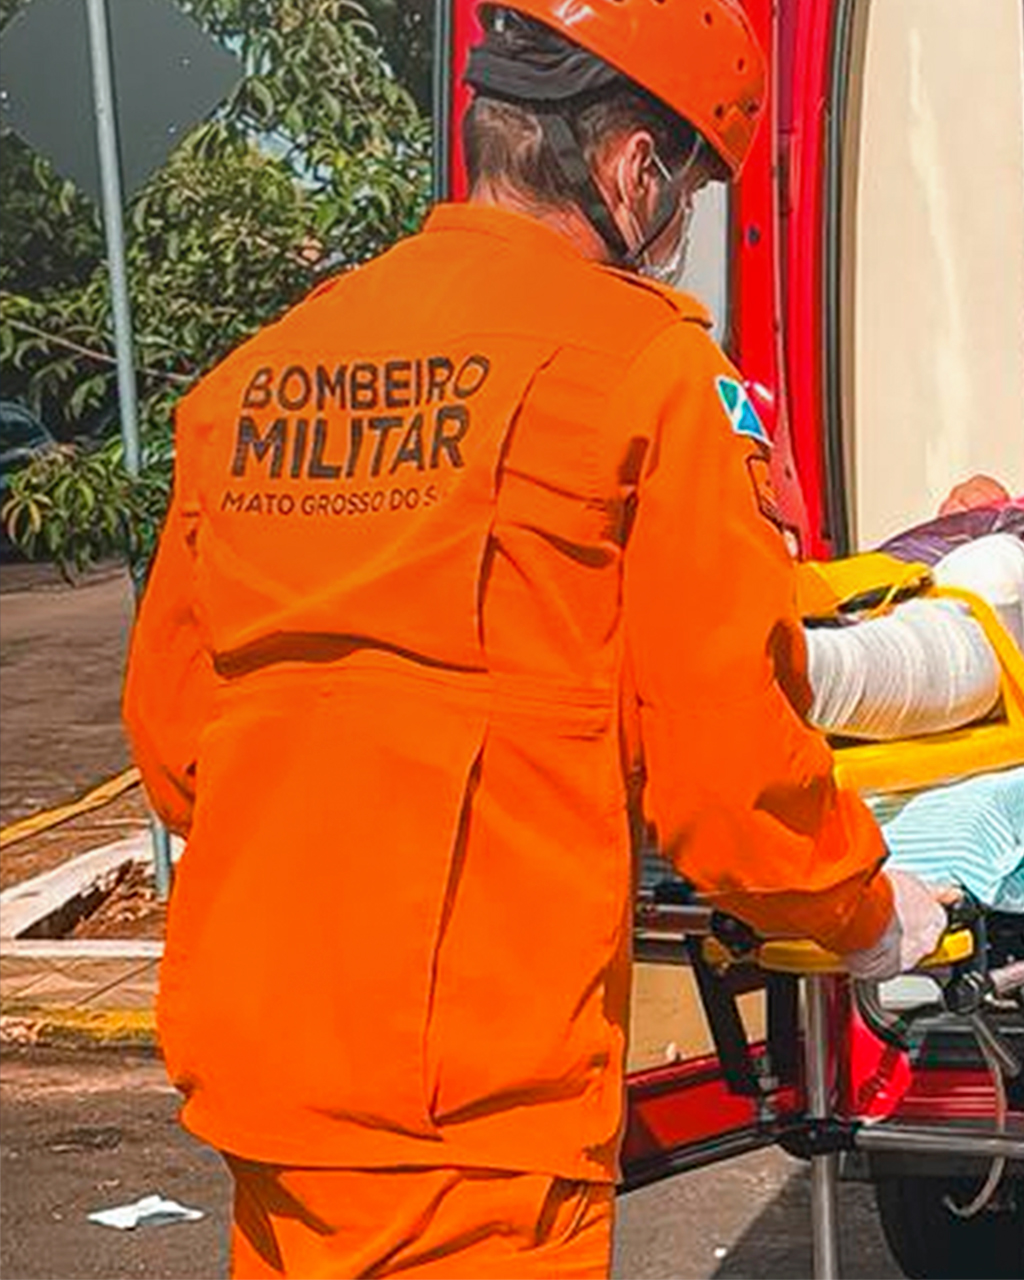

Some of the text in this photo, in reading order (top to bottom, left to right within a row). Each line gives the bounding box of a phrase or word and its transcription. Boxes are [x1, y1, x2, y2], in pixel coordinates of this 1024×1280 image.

[242, 355, 491, 411] BOMBEIRO
[230, 405, 471, 480] MILITAR
[221, 489, 296, 516] MATO
[300, 491, 385, 517] GROSSO
[389, 487, 420, 512] DO
